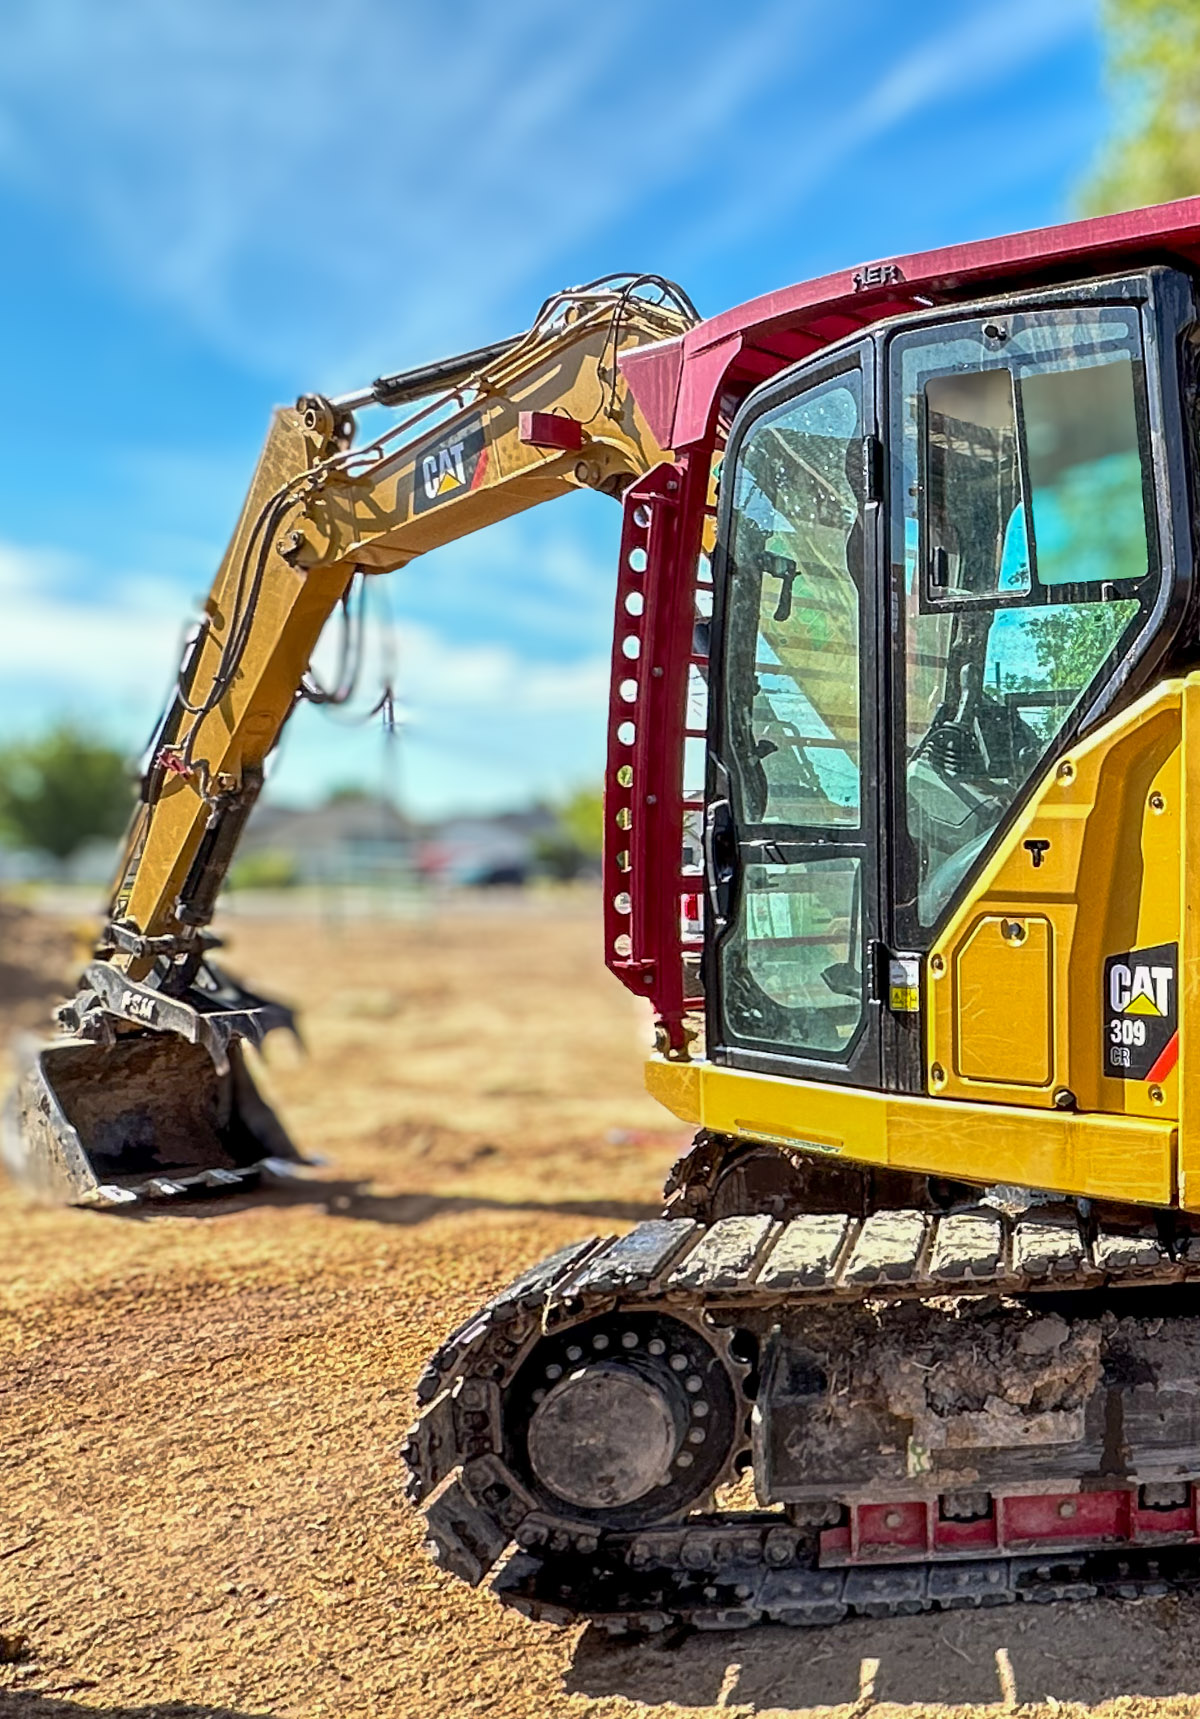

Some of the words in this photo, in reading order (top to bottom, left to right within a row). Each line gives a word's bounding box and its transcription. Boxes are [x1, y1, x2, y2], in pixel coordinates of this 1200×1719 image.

[422, 441, 466, 499] CAT
[1109, 963, 1174, 1017] CAT
[1110, 1019, 1146, 1047] 309
[1110, 1046, 1132, 1068] CR
